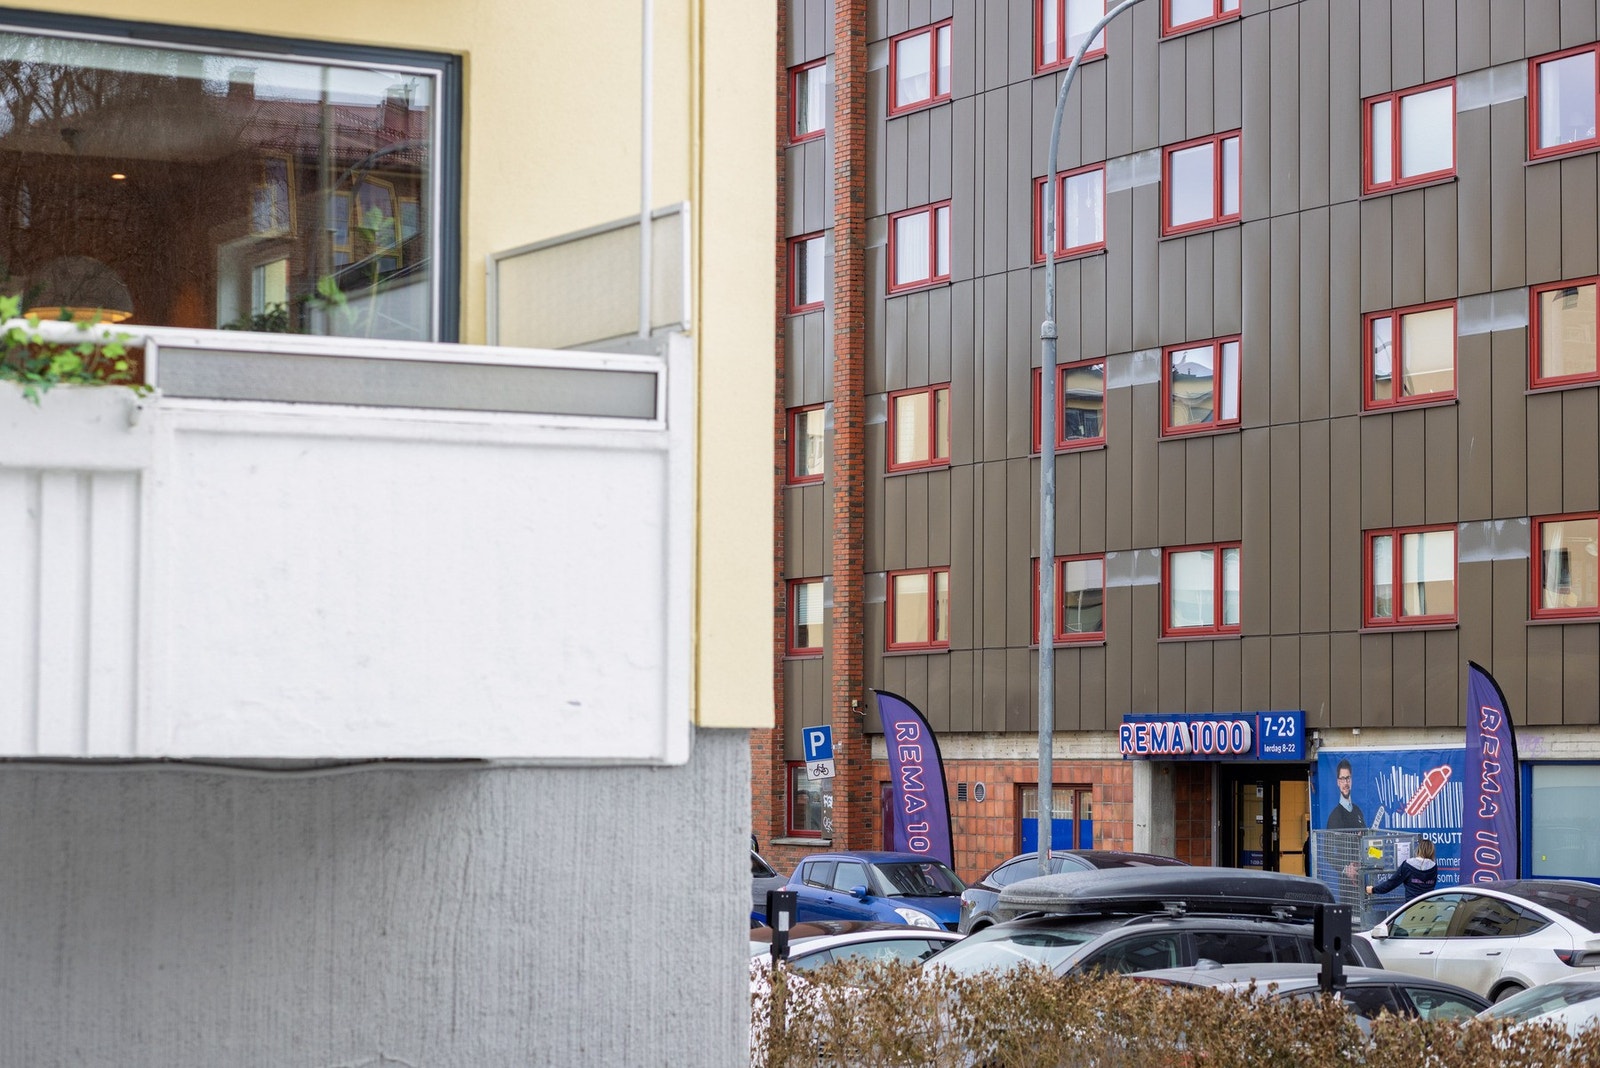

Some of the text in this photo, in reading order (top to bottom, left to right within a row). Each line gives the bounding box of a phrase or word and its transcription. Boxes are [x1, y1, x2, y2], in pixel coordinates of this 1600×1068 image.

[1119, 721, 1246, 755] REMA 1000
[1264, 716, 1295, 737] 7-23
[810, 731, 825, 757] P
[1264, 743, 1296, 753] lørdag 8-22
[895, 721, 931, 854] REMA 10
[1473, 706, 1502, 884] REMA 100
[1437, 874, 1453, 883] som
